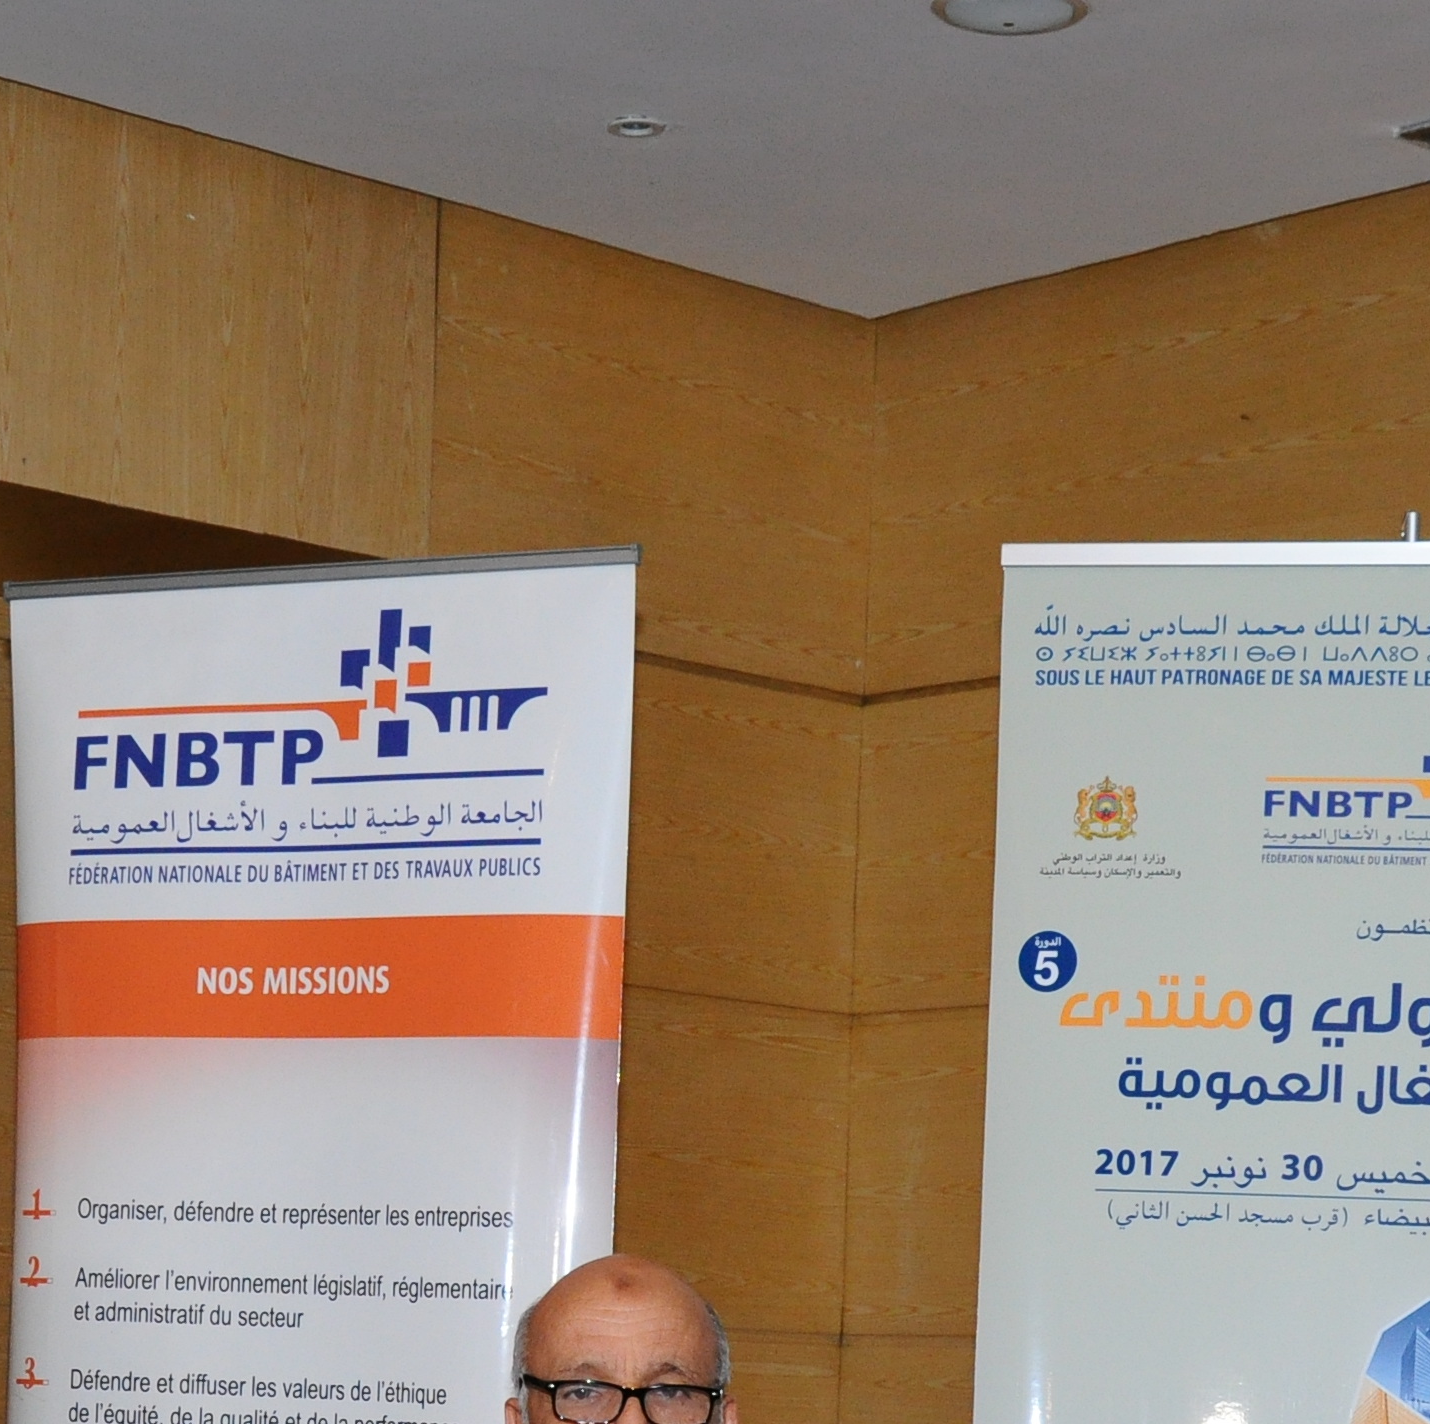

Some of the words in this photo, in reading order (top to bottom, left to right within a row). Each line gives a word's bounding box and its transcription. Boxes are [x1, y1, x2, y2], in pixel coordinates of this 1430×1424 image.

[1076, 618, 1130, 643] نصره
[1139, 614, 1227, 643] السادس
[1237, 621, 1305, 636] محمد
[1314, 614, 1370, 636] الملك
[1035, 669, 1080, 686] SOUS
[1084, 669, 1105, 686] LE
[1110, 669, 1157, 686] HAUT
[1161, 668, 1266, 686] PATRONAGE
[1271, 669, 1294, 686] DE
[1299, 669, 1323, 686] SA
[1328, 669, 1408, 687] MAJESTE
[73, 728, 325, 791] FNBTP
[460, 800, 543, 831] الجامعة
[1263, 790, 1414, 818] FNBTP
[72, 810, 175, 845] العمومية
[176, 801, 265, 844] الأشغال
[272, 820, 288, 842] و
[299, 807, 357, 838] للبناء
[366, 803, 451, 837] الوطنية
[68, 862, 153, 886] FÉDÉRATION
[158, 864, 242, 884] NATIONALE
[247, 864, 269, 883] DU
[274, 859, 348, 883] BÂTIMENT
[352, 861, 369, 881] ET
[373, 860, 400, 880] DES
[405, 858, 474, 879] TRAVAUX
[478, 856, 541, 877] PUBLICS
[1034, 935, 1062, 947] الدورة
[196, 966, 254, 995] NOS
[262, 965, 390, 995] MISSIONS
[1033, 950, 1060, 987] 5
[1118, 1056, 1343, 1111] العمومية
[1094, 1148, 1179, 1177] 2017
[1190, 1156, 1267, 1189] نونبر
[1281, 1153, 1324, 1182] 30
[77, 1197, 167, 1225] Organiser,
[173, 1200, 255, 1224] défendre
[259, 1203, 277, 1224] et
[282, 1202, 382, 1230] représenter
[385, 1204, 410, 1227] les
[414, 1205, 511, 1233] entreprises
[1176, 1202, 1230, 1227] الحسن
[1238, 1209, 1294, 1228] مسجد
[74, 1266, 161, 1290] Améliorer
[165, 1269, 308, 1295] l'environnement
[313, 1273, 386, 1302] législatif,
[392, 1275, 513, 1307] réglementaire
[73, 1300, 90, 1322] et
[94, 1300, 206, 1325] administratif
[209, 1304, 232, 1326] du
[237, 1307, 304, 1328] secteur
[70, 1368, 151, 1393] Défendre
[156, 1373, 174, 1394] et
[179, 1373, 247, 1397] diffuser
[251, 1375, 277, 1398] les
[282, 1377, 345, 1401] valeurs
[350, 1379, 372, 1402] de
[376, 1380, 447, 1410] l'éthique
[68, 1401, 90, 1424] de
